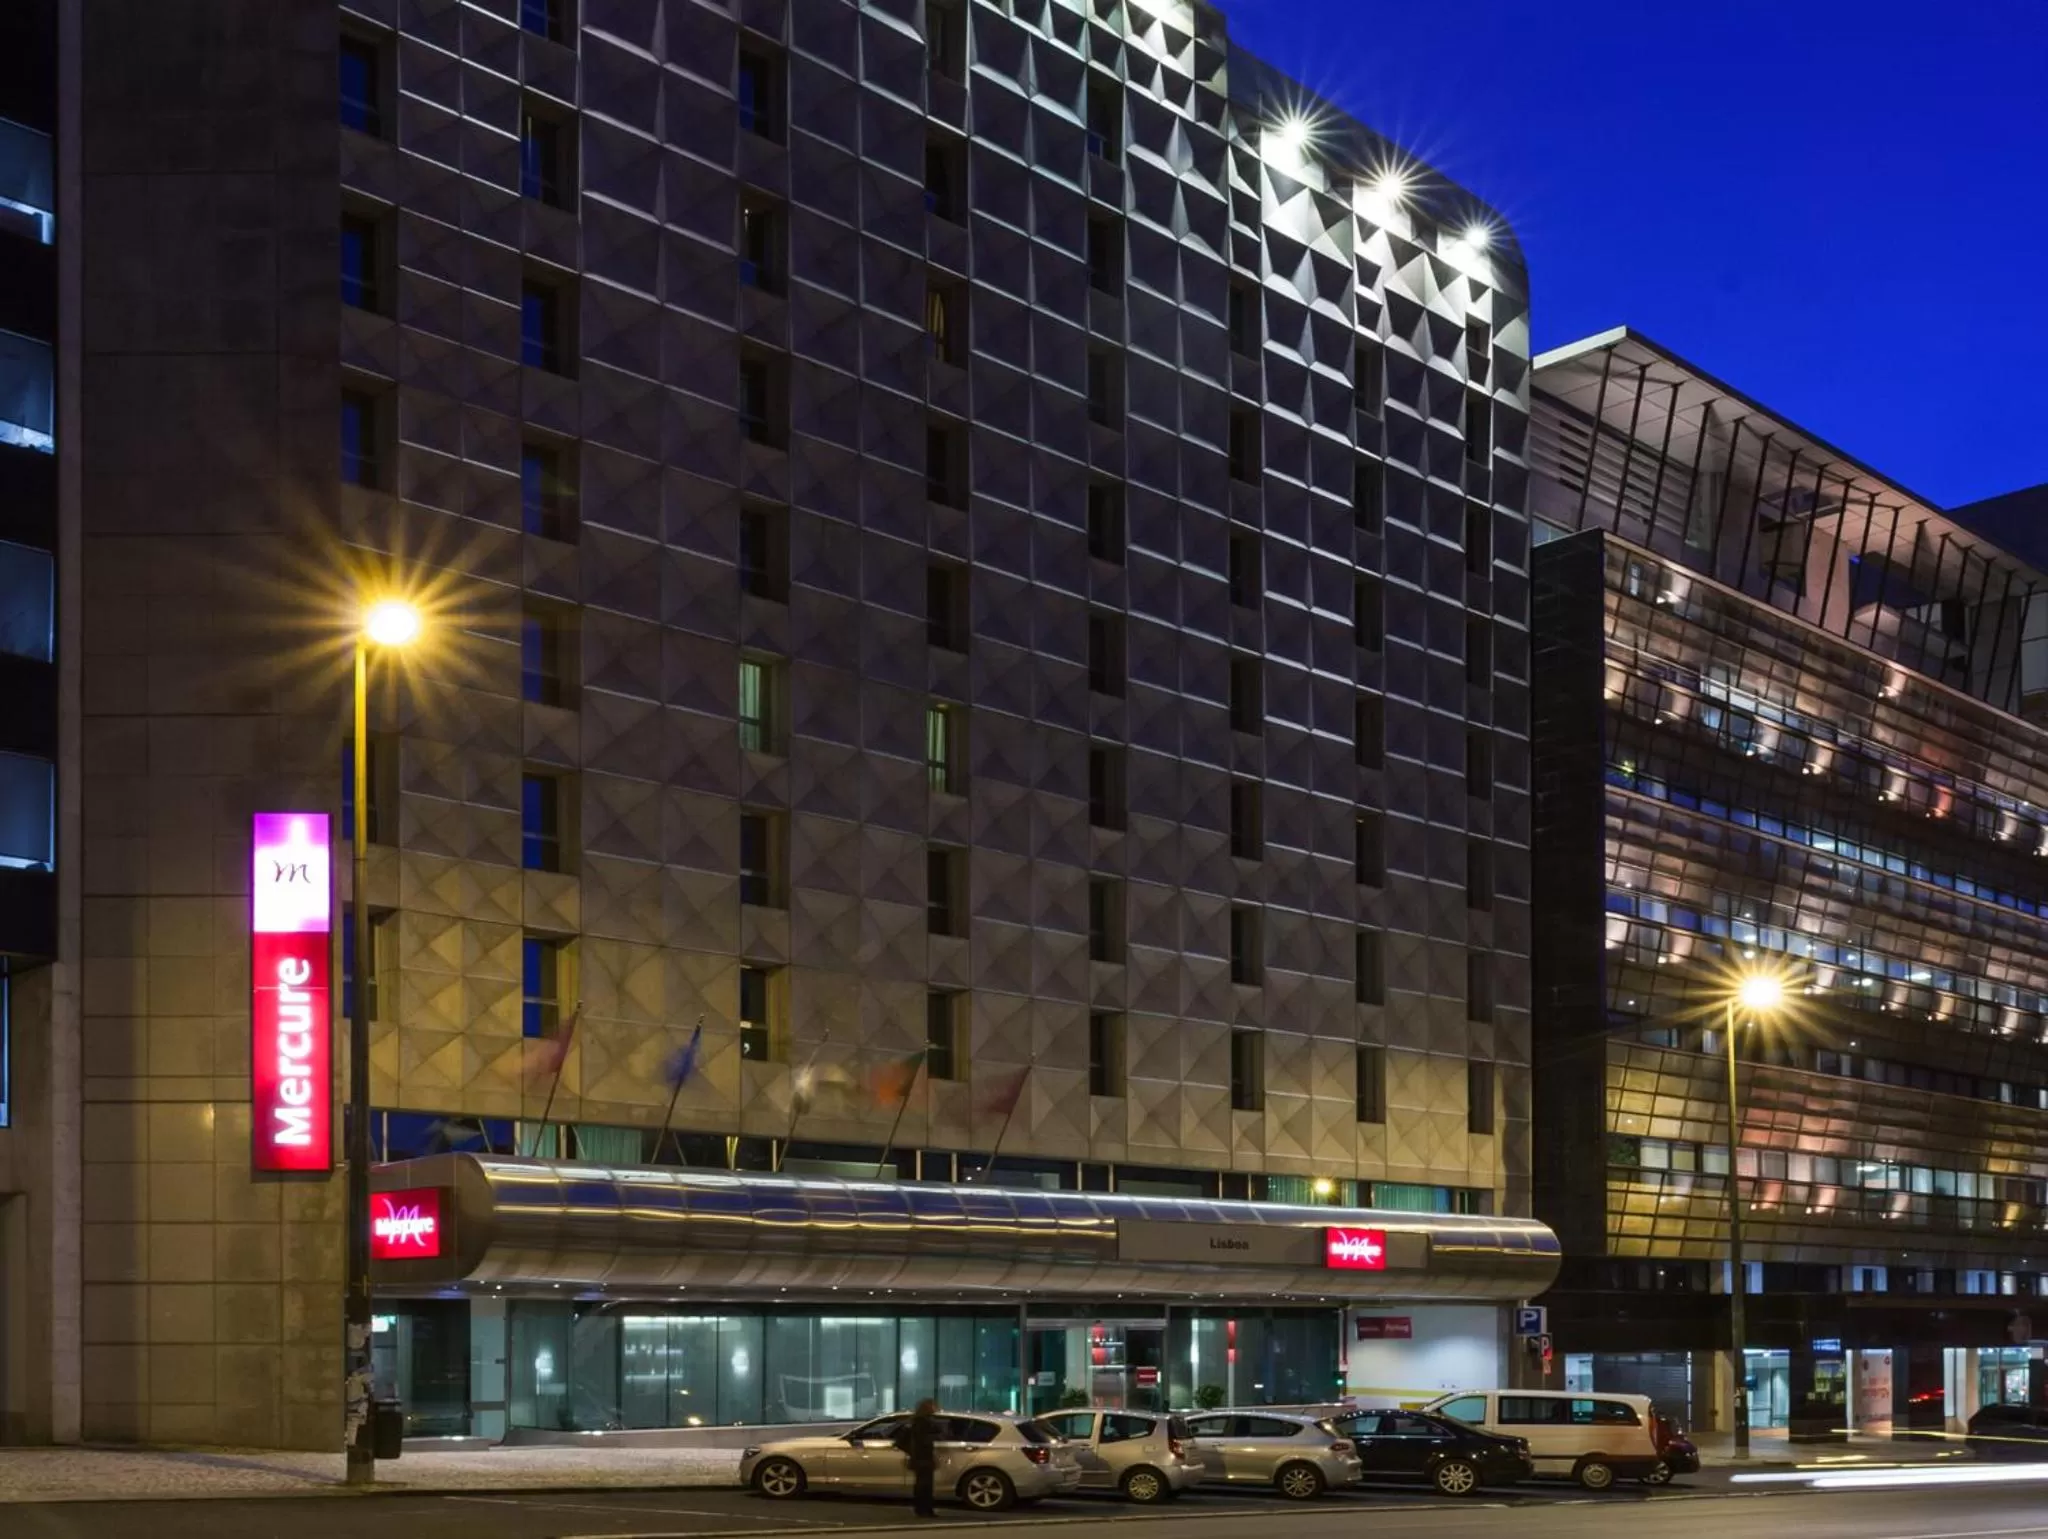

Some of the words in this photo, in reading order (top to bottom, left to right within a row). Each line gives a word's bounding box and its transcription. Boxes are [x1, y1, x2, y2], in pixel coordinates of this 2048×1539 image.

[273, 957, 312, 1145] Mercure
[1210, 1236, 1249, 1250] Lisboa
[1520, 1310, 1538, 1328] P
